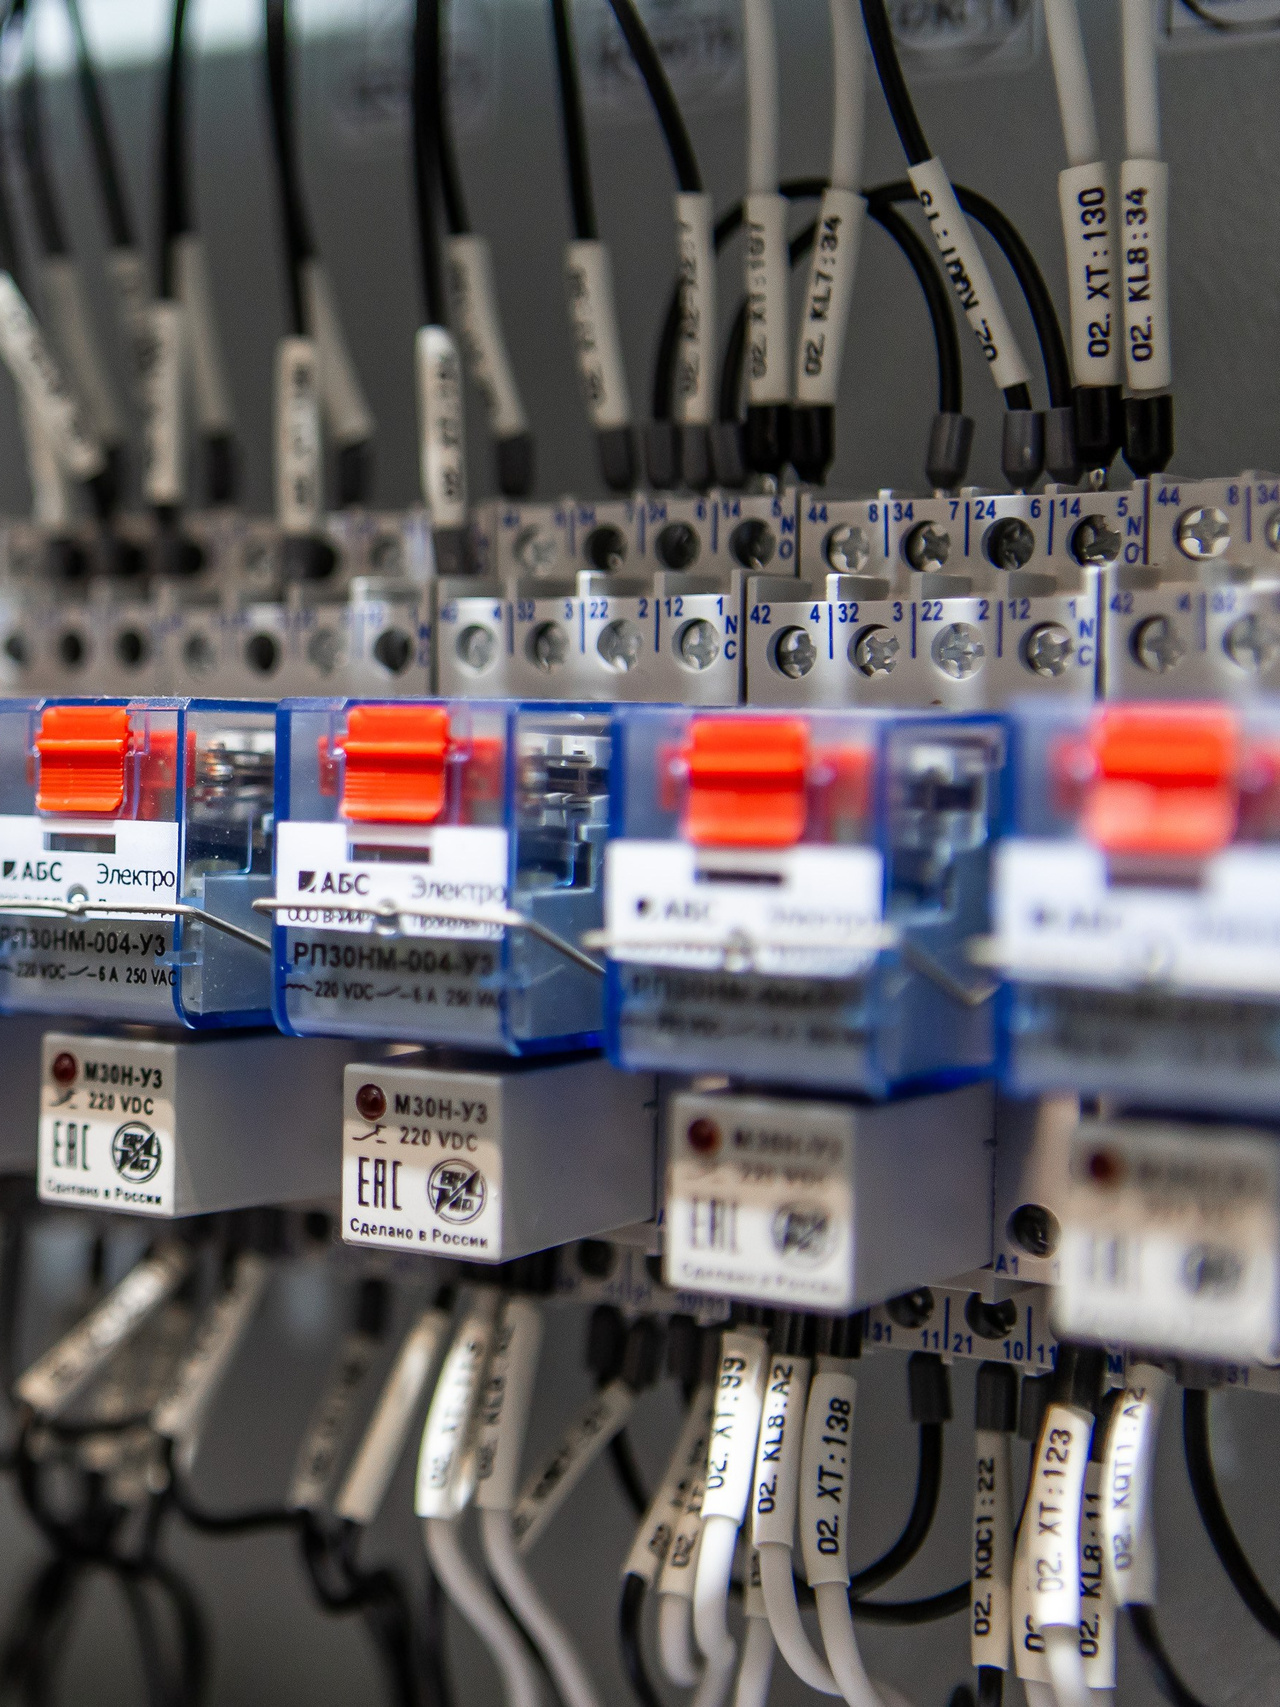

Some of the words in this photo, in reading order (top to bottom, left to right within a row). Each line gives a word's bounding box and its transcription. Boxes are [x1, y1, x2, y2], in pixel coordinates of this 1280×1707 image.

[1077, 186, 1111, 302] XT:130
[1124, 186, 1152, 304] KL8:34
[1087, 311, 1113, 359] 02.
[1129, 314, 1155, 362] 02.
[1117, 497, 1129, 517] 5
[1157, 486, 1181, 507] 44
[807, 504, 829, 524] 44
[868, 503, 879, 523] 8
[893, 501, 915, 522] 34
[948, 500, 960, 521] 7
[974, 500, 997, 520] 24
[1030, 498, 1042, 519] 6
[1059, 498, 1082, 518] 14
[589, 601, 609, 619] 22
[638, 598, 649, 619] 2
[664, 597, 684, 618] 12
[715, 596, 724, 616] 1
[749, 603, 772, 625] 42
[809, 603, 821, 624] 4
[837, 602, 860, 624] 32
[892, 601, 904, 623] 3
[920, 600, 945, 622] 22
[978, 600, 991, 621] 2
[1008, 599, 1031, 620] 12
[22, 860, 63, 882] АБС
[96, 862, 176, 892] Электро
[320, 871, 370, 896] АБС
[410, 875, 507, 906] Электро
[98, 965, 106, 983] 6
[108, 966, 119, 983] A
[125, 967, 148, 985] 250
[151, 968, 178, 987] VAC
[314, 980, 338, 999] 220
[344, 982, 374, 1002] VDC
[88, 1091, 116, 1111] 220
[120, 1096, 155, 1116] VDC
[399, 1125, 432, 1147] 220
[437, 1130, 479, 1153] VDC
[116, 1187, 163, 1206] России
[349, 1217, 414, 1241] Сделано
[418, 1230, 427, 1242] в
[432, 1228, 489, 1250] России
[994, 1253, 1019, 1276] A1
[873, 1321, 892, 1343] 31
[921, 1329, 940, 1349] 11
[953, 1333, 973, 1353] 21
[1002, 1339, 1024, 1361] 10
[713, 1357, 747, 1439] XT:99
[761, 1362, 795, 1465] KL8:A2
[817, 1395, 854, 1505] XT:138
[1037, 1426, 1074, 1539] XT:123
[757, 1474, 777, 1515] 02.
[973, 1456, 997, 1581] KQC1:22
[818, 1513, 841, 1556] 02.
[1035, 1541, 1066, 1595] 02.
[972, 1591, 993, 1638] 02.
[1075, 1611, 1101, 1660] 02.
